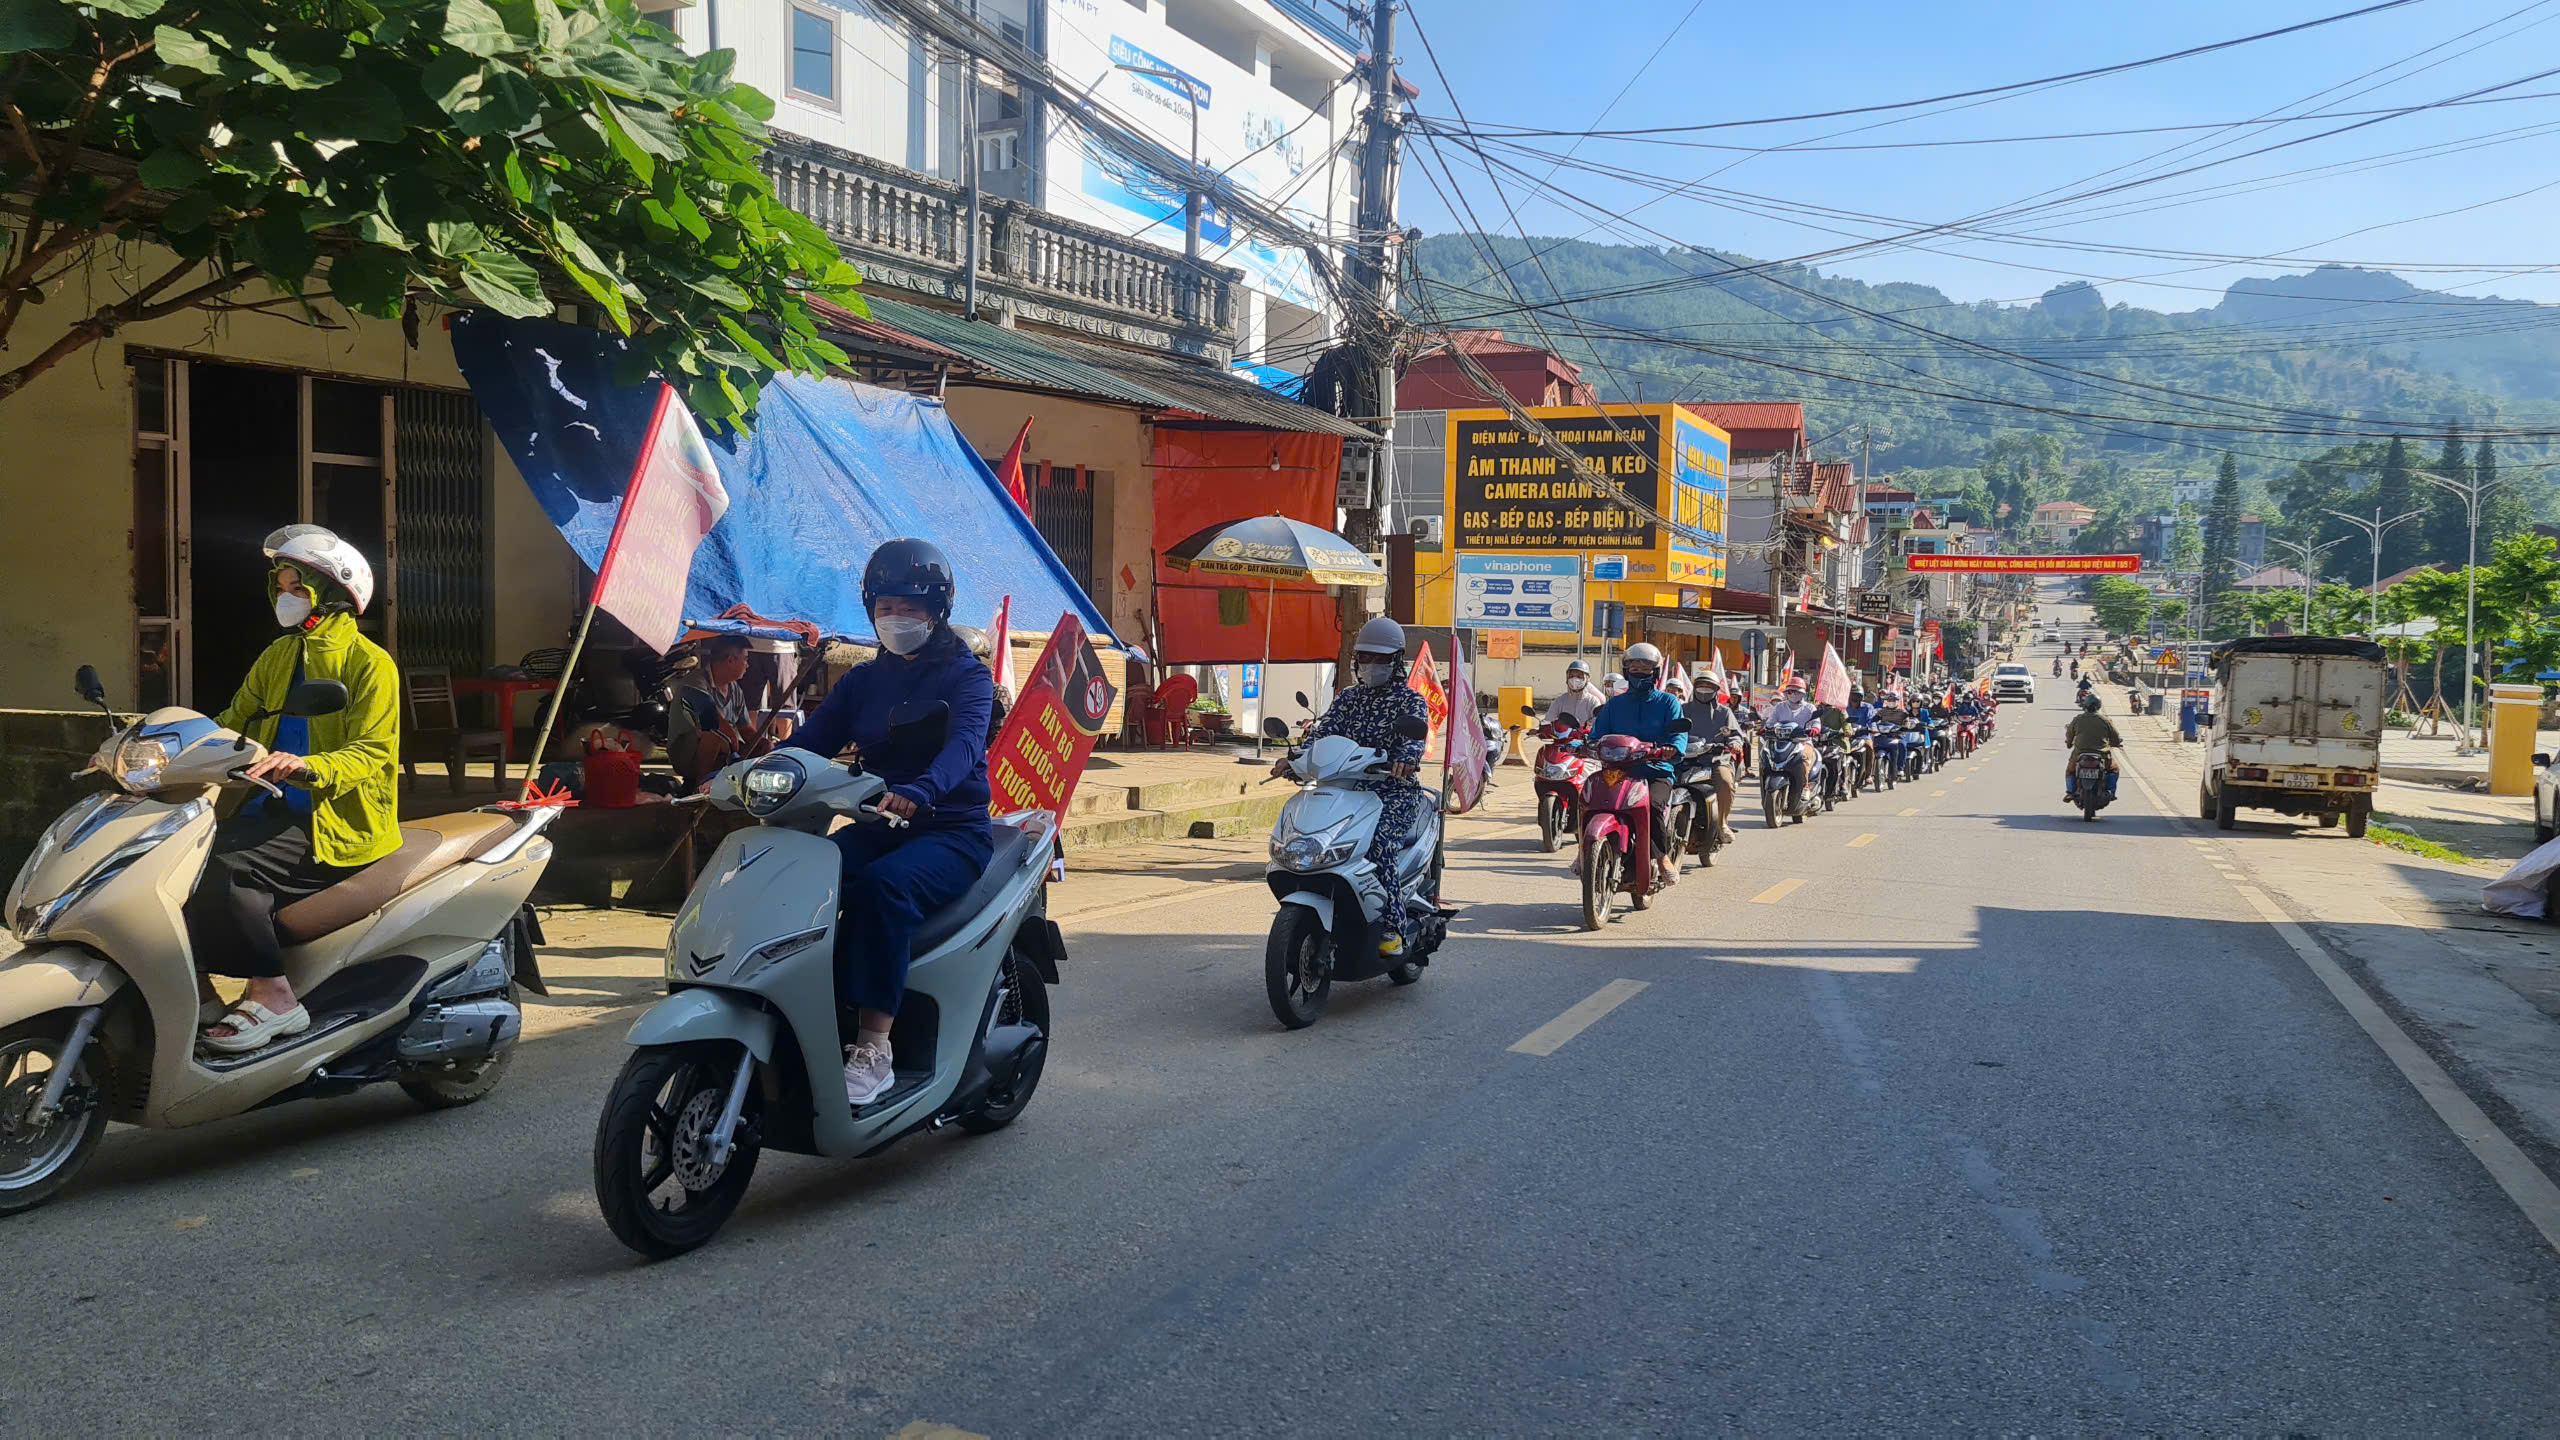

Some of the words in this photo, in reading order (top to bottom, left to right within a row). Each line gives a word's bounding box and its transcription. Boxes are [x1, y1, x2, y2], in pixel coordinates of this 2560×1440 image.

[1112, 41, 1131, 62] SIÊU
[1472, 430, 1496, 446] ĐIỆN
[1498, 429, 1520, 444] MÁY
[1555, 430, 1586, 444] THOẠI
[1588, 430, 1612, 442] NAM
[1615, 427, 1646, 442] NGÂN
[1468, 455, 1495, 476] ÂM
[1500, 457, 1556, 475] THANH
[1578, 456, 1606, 474] OA
[1612, 452, 1646, 474] KÉO
[1485, 482, 1549, 499] CAMERA
[1552, 479, 1592, 499] GIÁM
[1463, 511, 1489, 528] GAS
[1500, 505, 1524, 528] BẾP
[1527, 511, 1554, 528] GAS
[1565, 505, 1589, 528] BẾP
[1593, 507, 1624, 531] ĐIỆN
[1465, 532, 1485, 545] THIẾT
[1486, 535, 1493, 546] BỊ
[1494, 534, 1509, 545] NHÀ
[1510, 532, 1525, 545] BẾP
[1526, 535, 1541, 545] CAO
[1542, 532, 1557, 545] CẤP
[1563, 535, 1578, 546] PHỤ
[1579, 534, 1596, 546] KIỆN
[1597, 534, 1620, 545] CHÍNH
[1621, 535, 1643, 545] HÀNG
[1243, 549, 1293, 560] XANH
[1229, 562, 1242, 571] GÓP
[1261, 564, 1278, 574] HÀNG
[1279, 567, 1304, 577] ONLINE
[1484, 560, 1552, 573] vinaphone
[1627, 559, 1657, 573] idea
[1040, 702, 1062, 742] HÃY
[1057, 731, 1075, 762] BỎ
[1016, 727, 1053, 784] THUỐC
[1049, 773, 1067, 804] LÁ
[995, 757, 1036, 809] TRƯỚC
